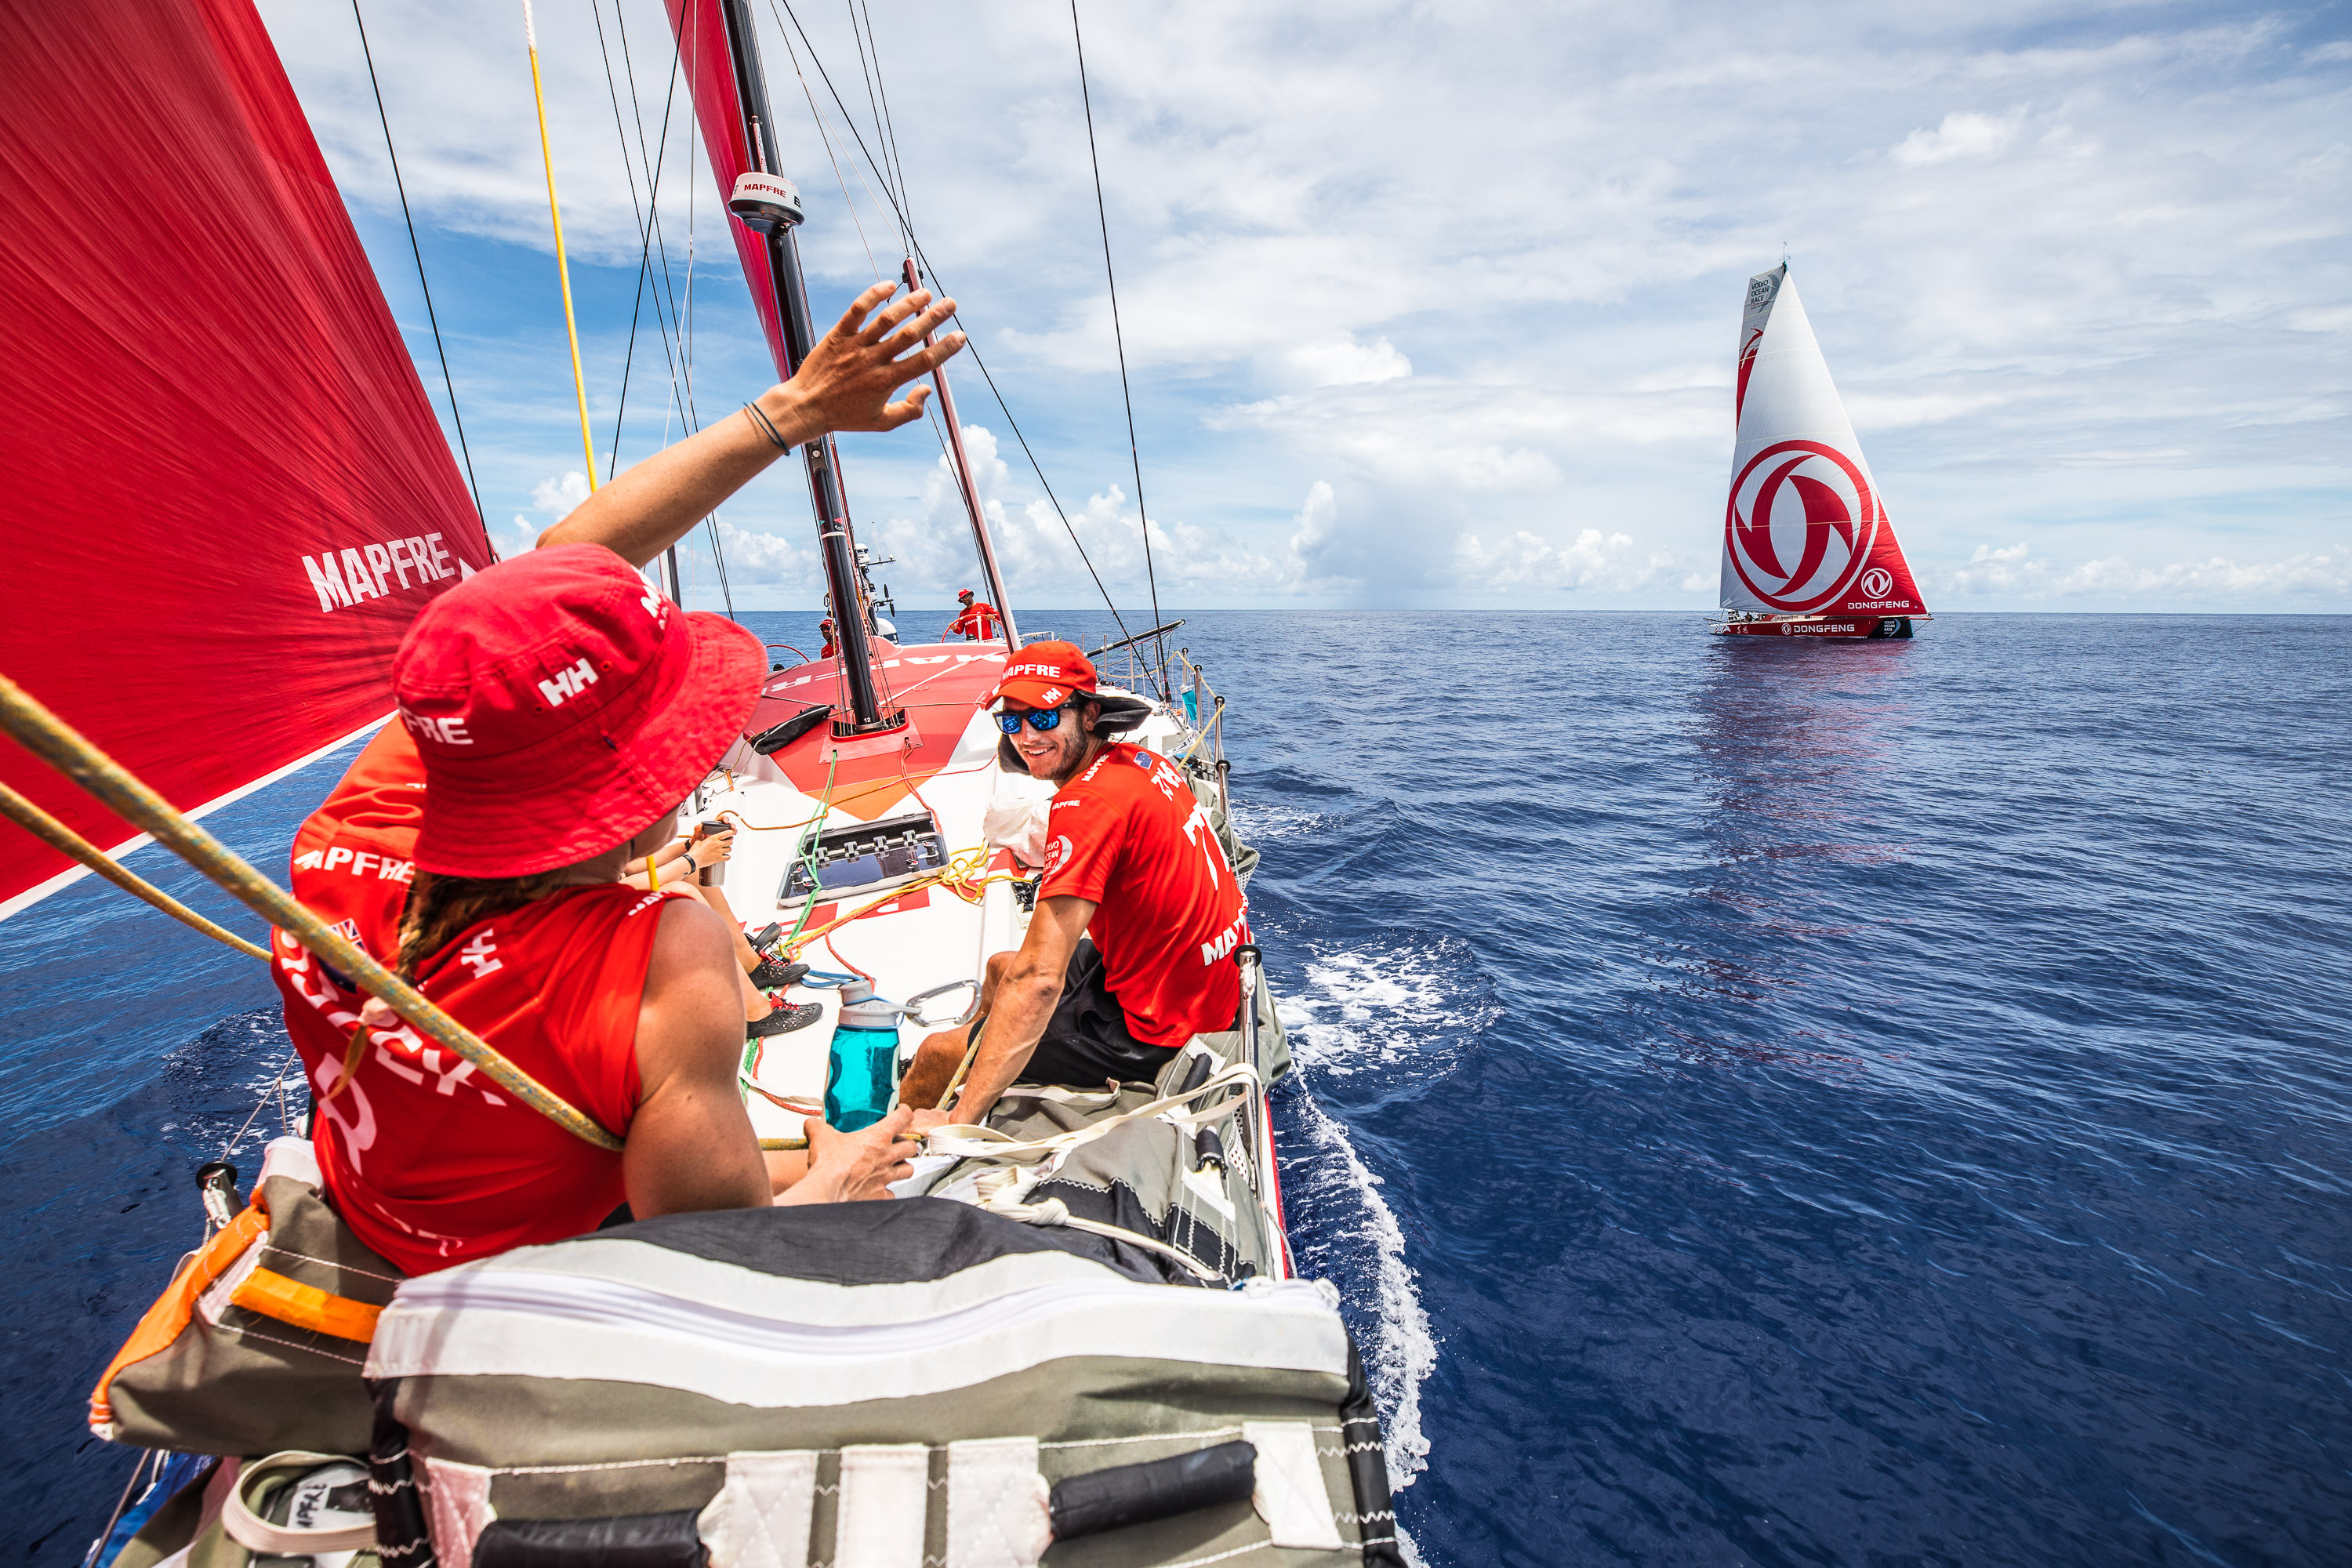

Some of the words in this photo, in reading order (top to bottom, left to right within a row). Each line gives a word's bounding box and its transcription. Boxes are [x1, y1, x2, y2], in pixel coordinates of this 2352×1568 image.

[744, 183, 786, 198] MAPFRE
[1751, 279, 1769, 290] VOLVO
[1751, 286, 1769, 297] OCEAN
[1751, 295, 1764, 304] RACE
[301, 532, 456, 613] MAPFRE
[1847, 601, 1910, 610] DONGFENG
[1794, 624, 1855, 633] DONGFENG
